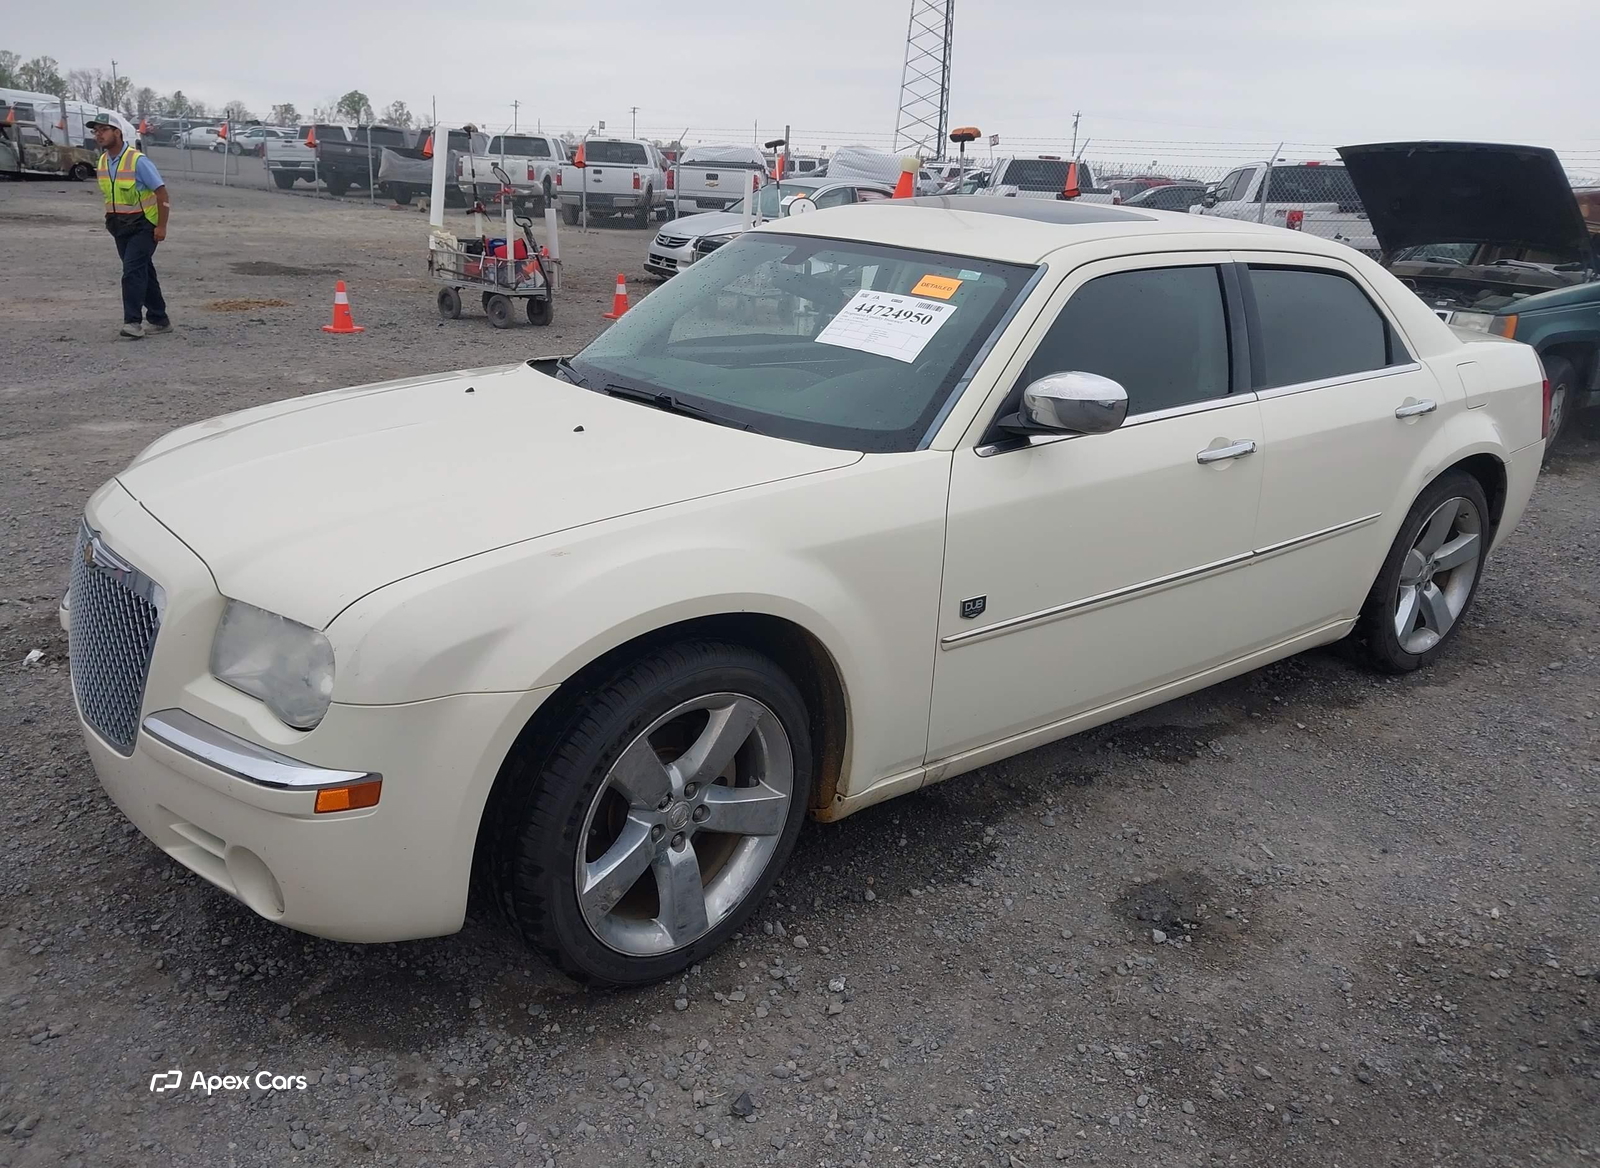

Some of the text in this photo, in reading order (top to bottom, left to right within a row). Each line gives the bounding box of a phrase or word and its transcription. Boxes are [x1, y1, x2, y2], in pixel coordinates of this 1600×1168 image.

[921, 282, 953, 291] DETAILED
[854, 303, 933, 325] 44724950
[966, 600, 983, 611] DUB
